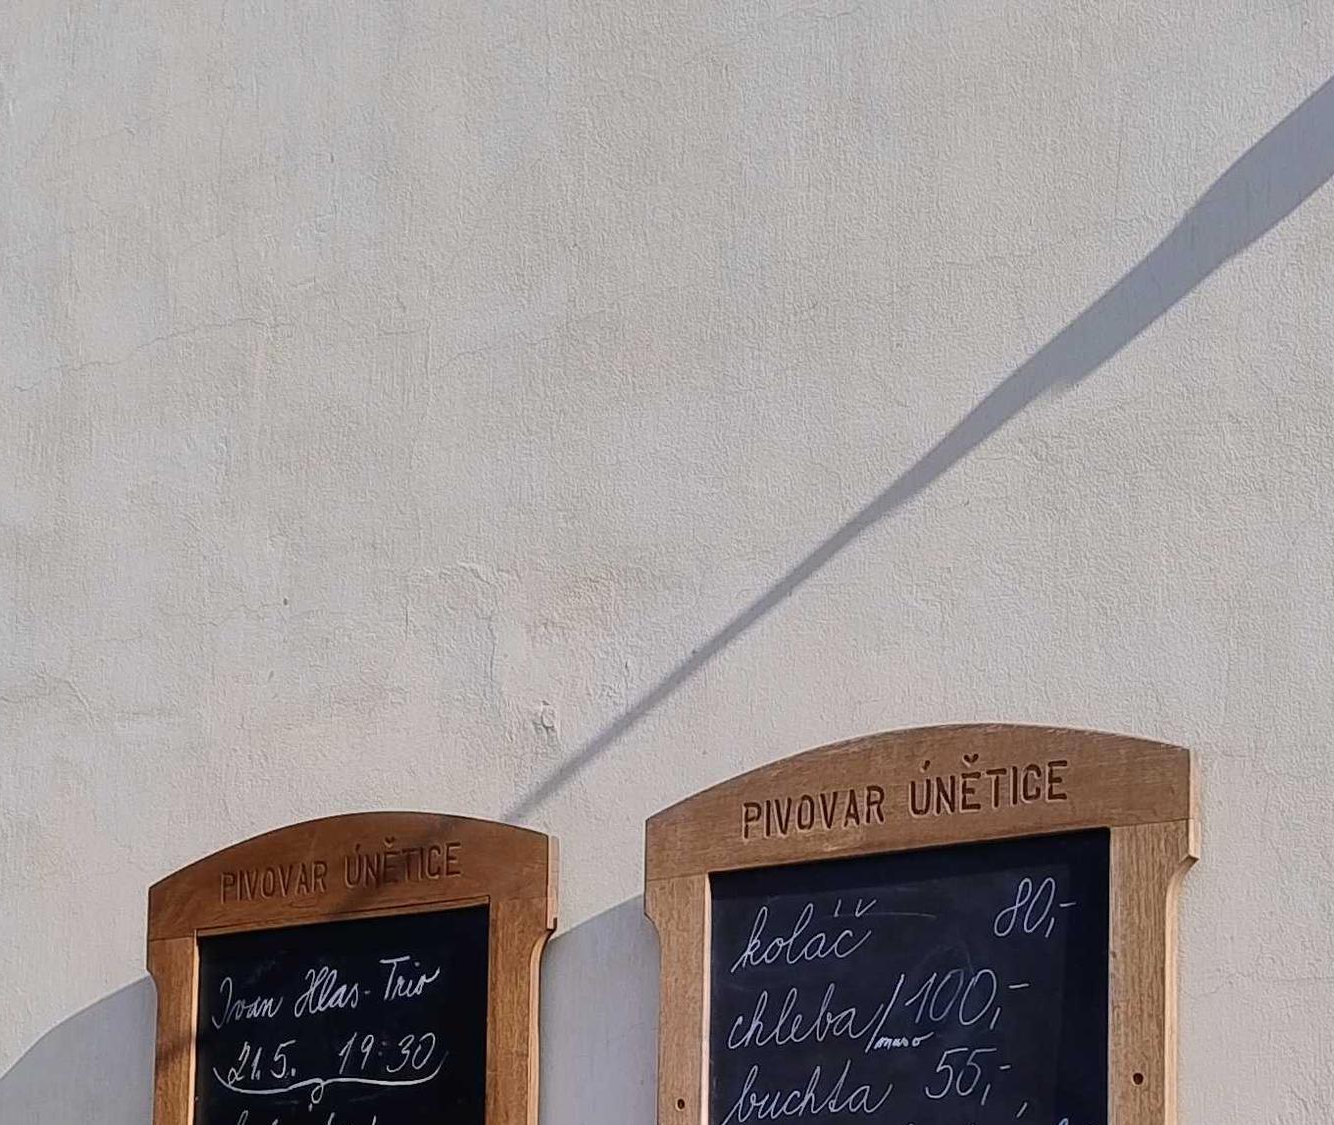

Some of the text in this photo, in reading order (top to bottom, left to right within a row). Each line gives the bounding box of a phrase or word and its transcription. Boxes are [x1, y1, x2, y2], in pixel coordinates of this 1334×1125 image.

[741, 753, 1069, 840] PIVOVAR ÚNĚTICE
[219, 836, 464, 905] PIVOVAR ÚNĚTICE
[731, 899, 876, 973] koláč
